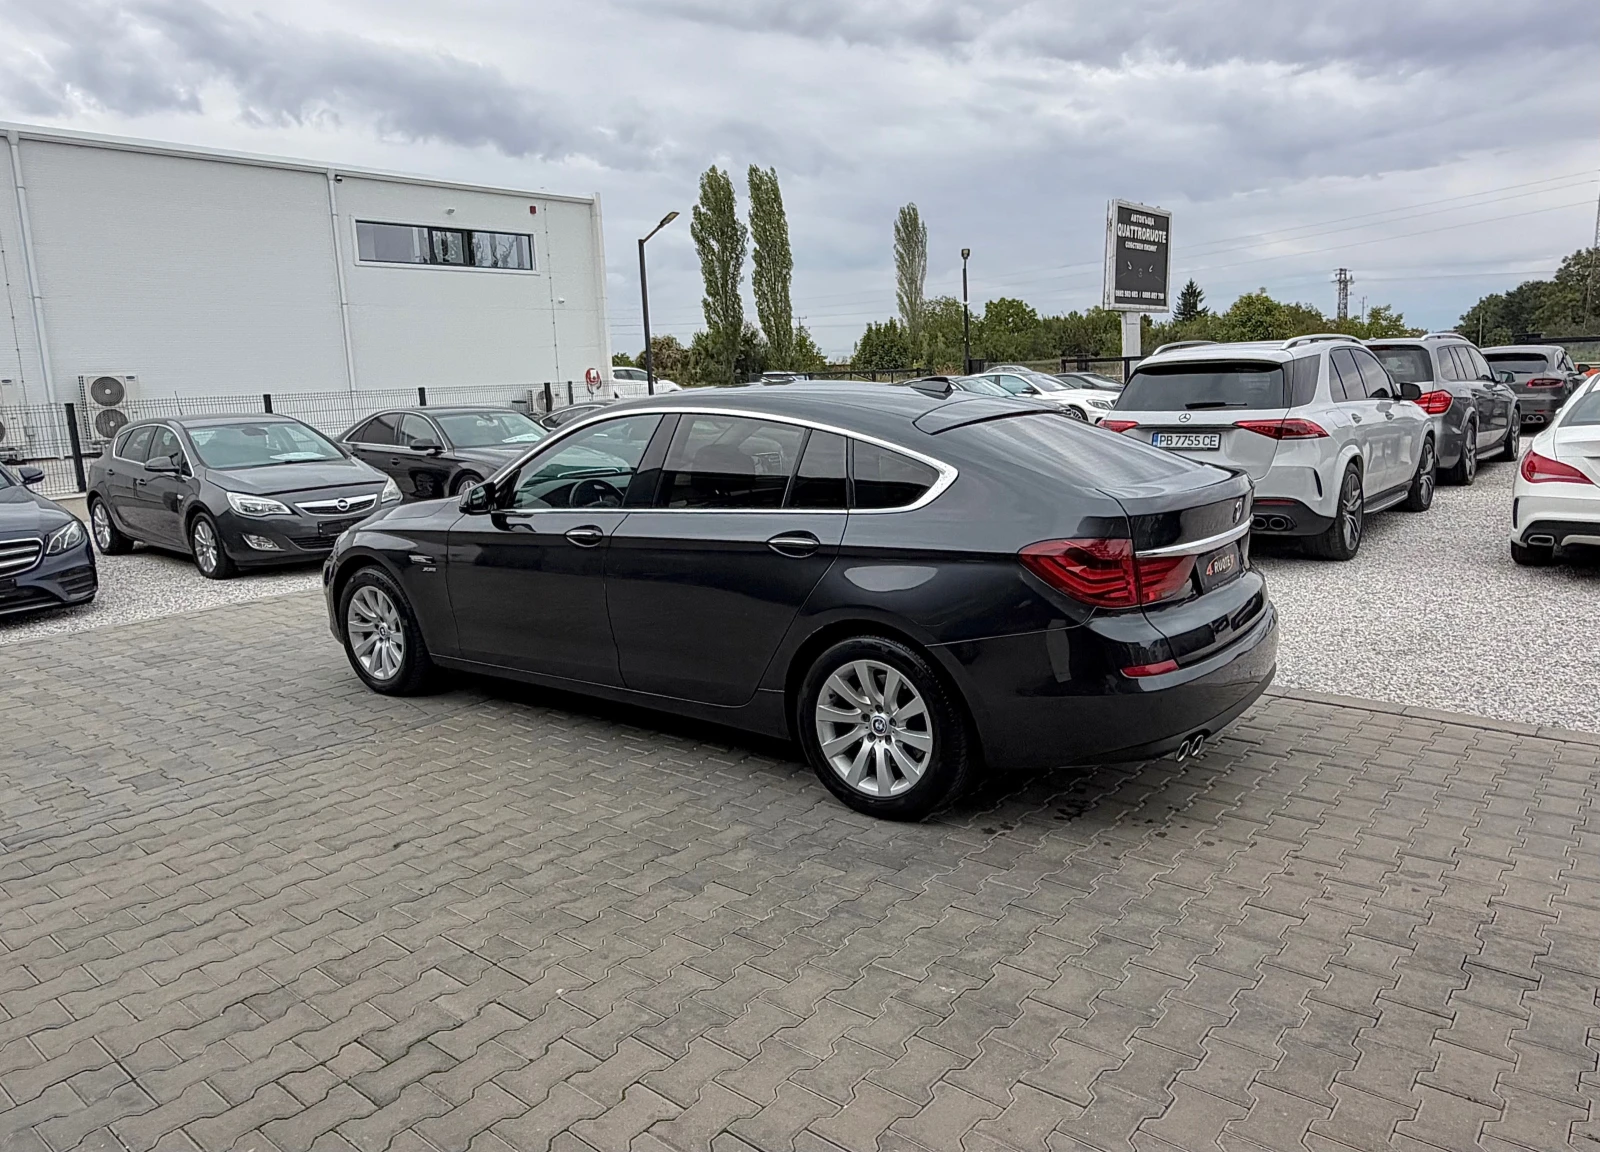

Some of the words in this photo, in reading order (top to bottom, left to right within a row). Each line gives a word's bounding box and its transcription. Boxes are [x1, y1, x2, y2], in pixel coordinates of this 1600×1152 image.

[1118, 222, 1166, 244] QUATTRORUOTE
[1159, 435, 1173, 446] PB
[1174, 435, 1201, 446] 7755
[1202, 435, 1217, 447] CE
